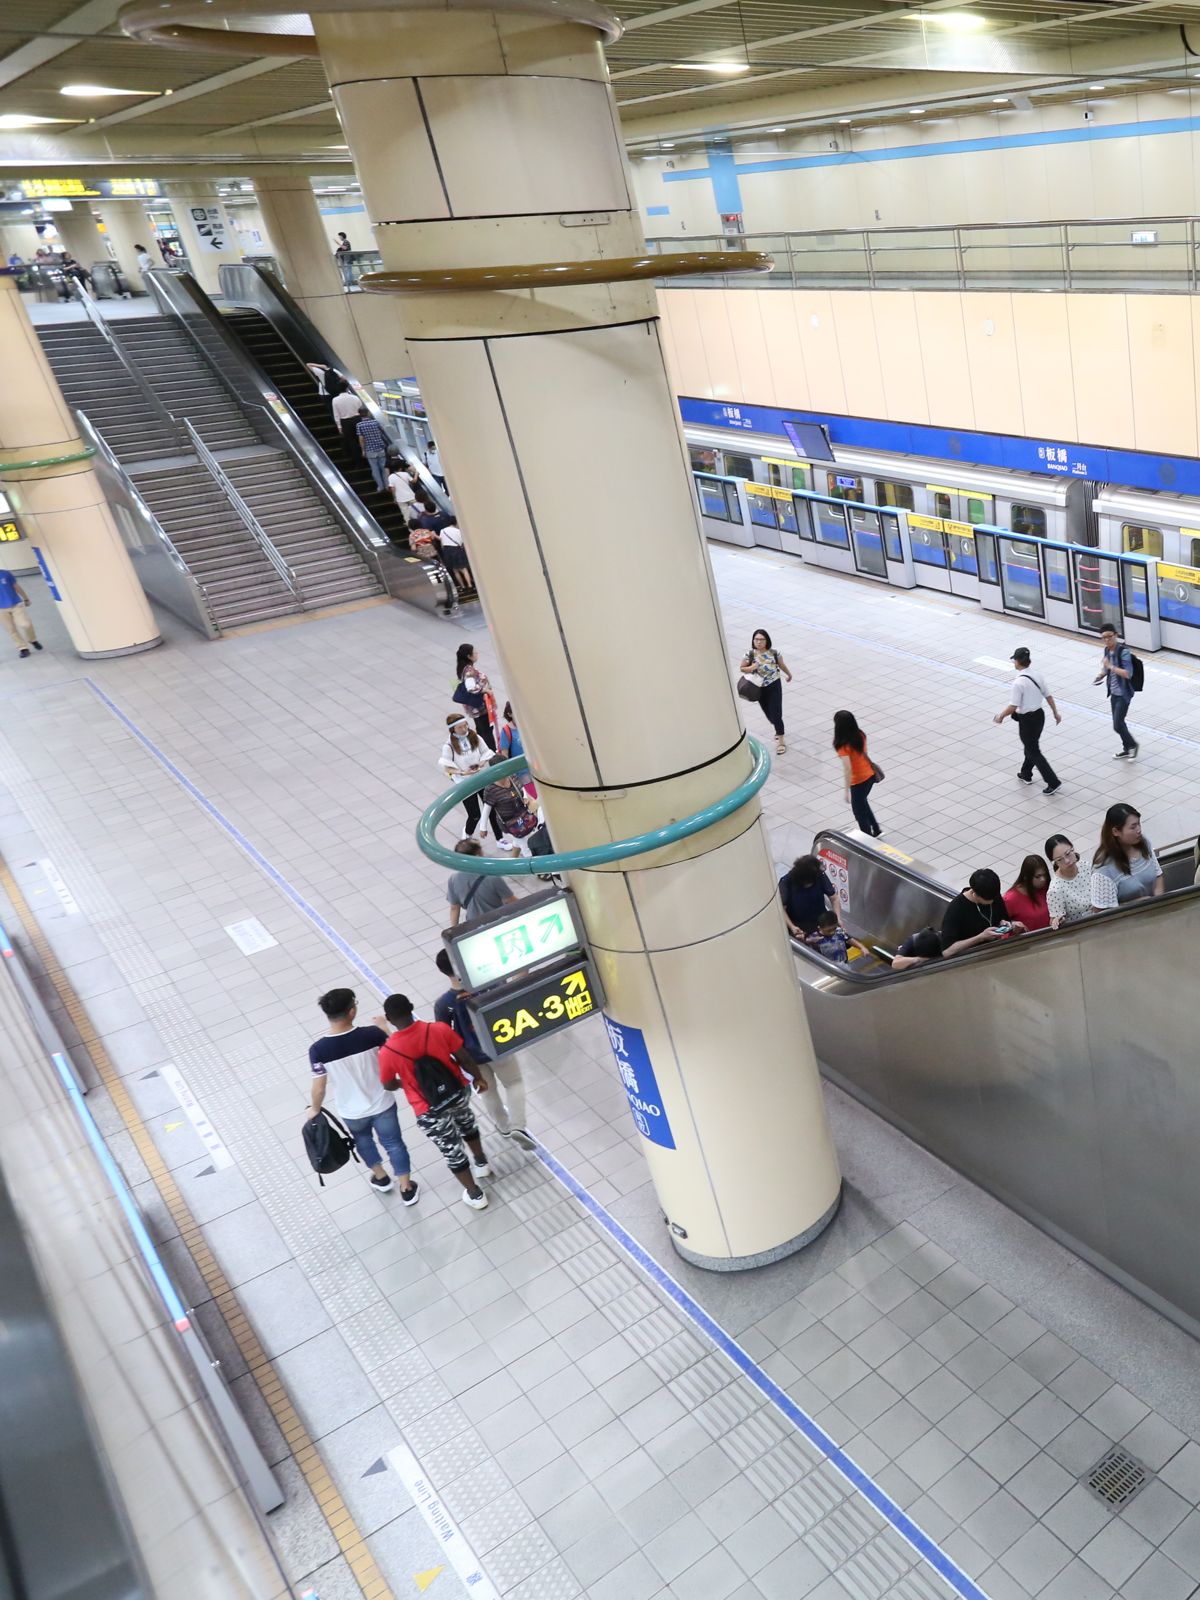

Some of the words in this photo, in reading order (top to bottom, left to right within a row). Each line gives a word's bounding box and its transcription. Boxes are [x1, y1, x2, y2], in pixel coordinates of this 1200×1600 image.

[1046, 446, 1067, 463] 板橋
[564, 990, 592, 1020] 出口
[414, 1479, 432, 1504] Line
[427, 1501, 455, 1542] Waiting
